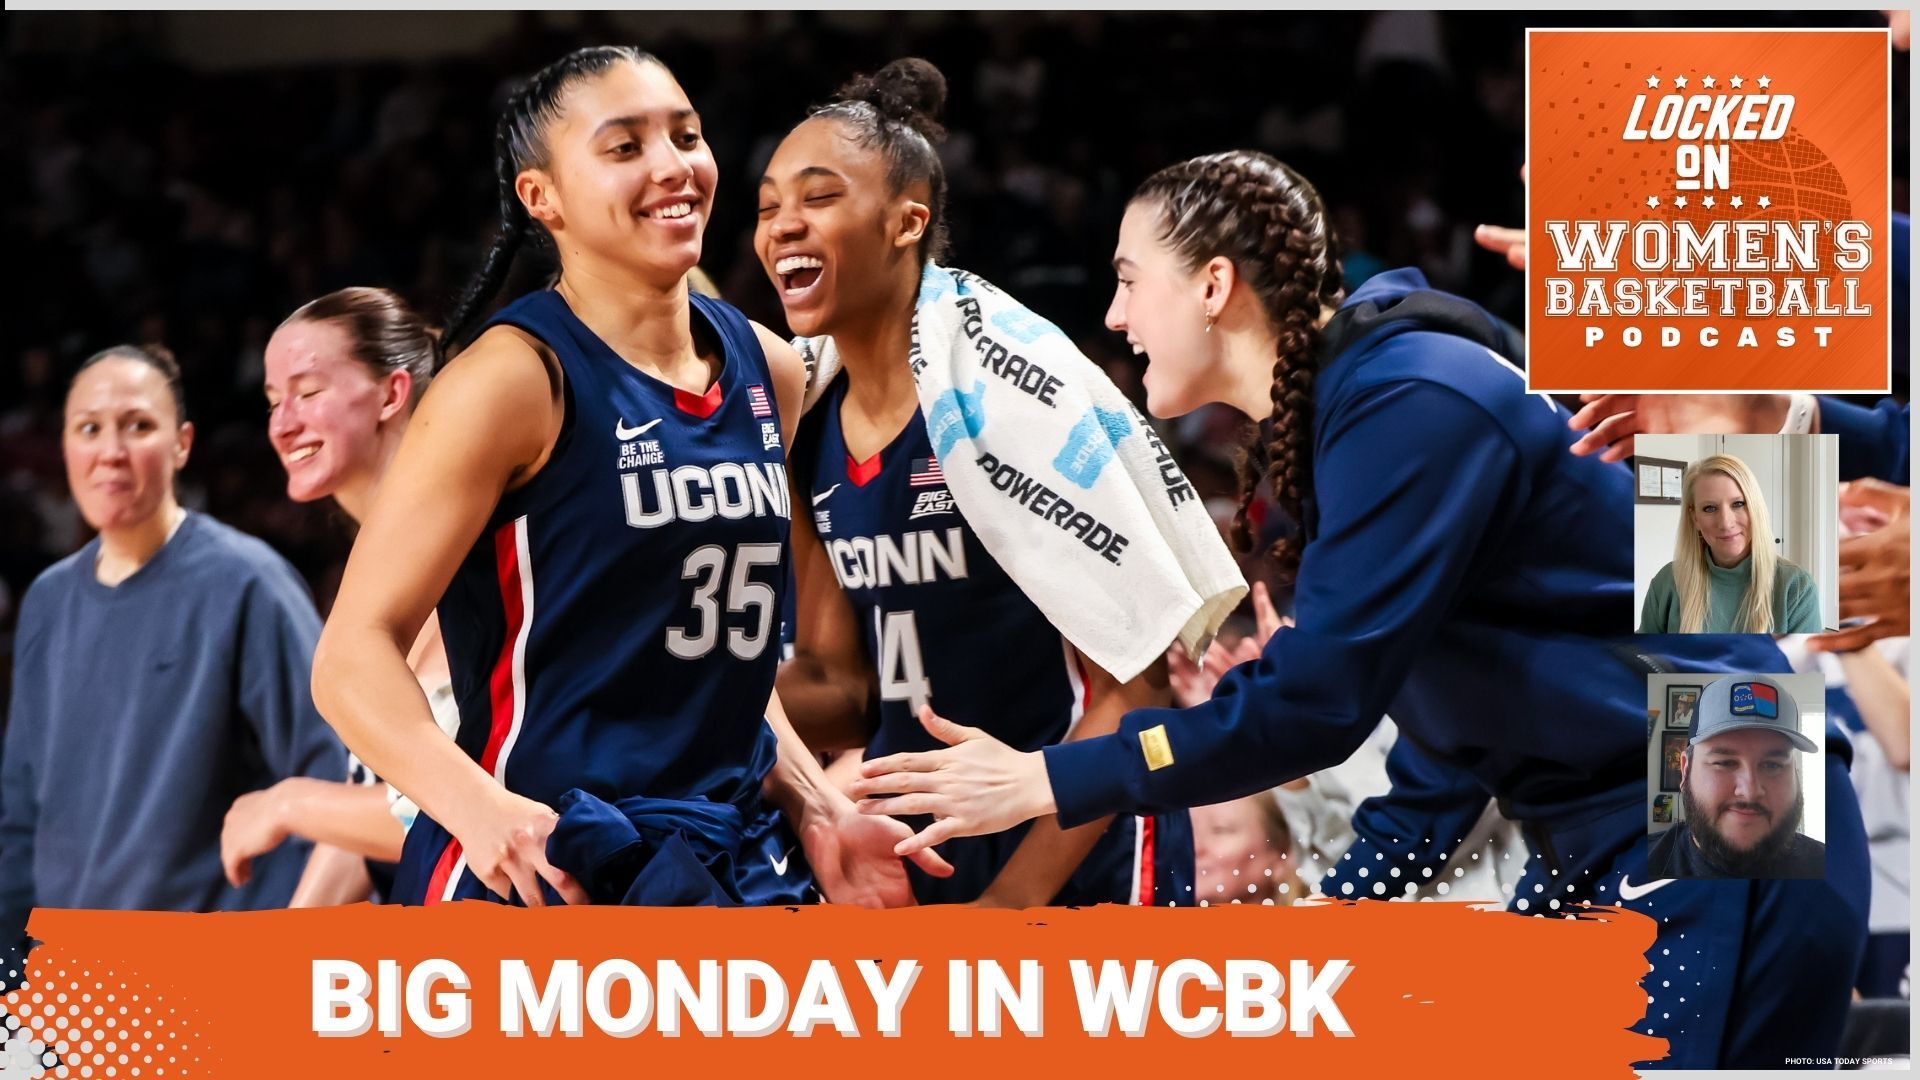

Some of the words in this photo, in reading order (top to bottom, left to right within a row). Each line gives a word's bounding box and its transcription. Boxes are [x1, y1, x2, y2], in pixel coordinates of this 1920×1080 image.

[621, 443, 636, 457] BE
[638, 441, 660, 454] THE
[618, 452, 665, 469] CHANGE
[912, 501, 955, 514] EAST
[825, 527, 968, 589] CONN
[665, 543, 782, 660] 35
